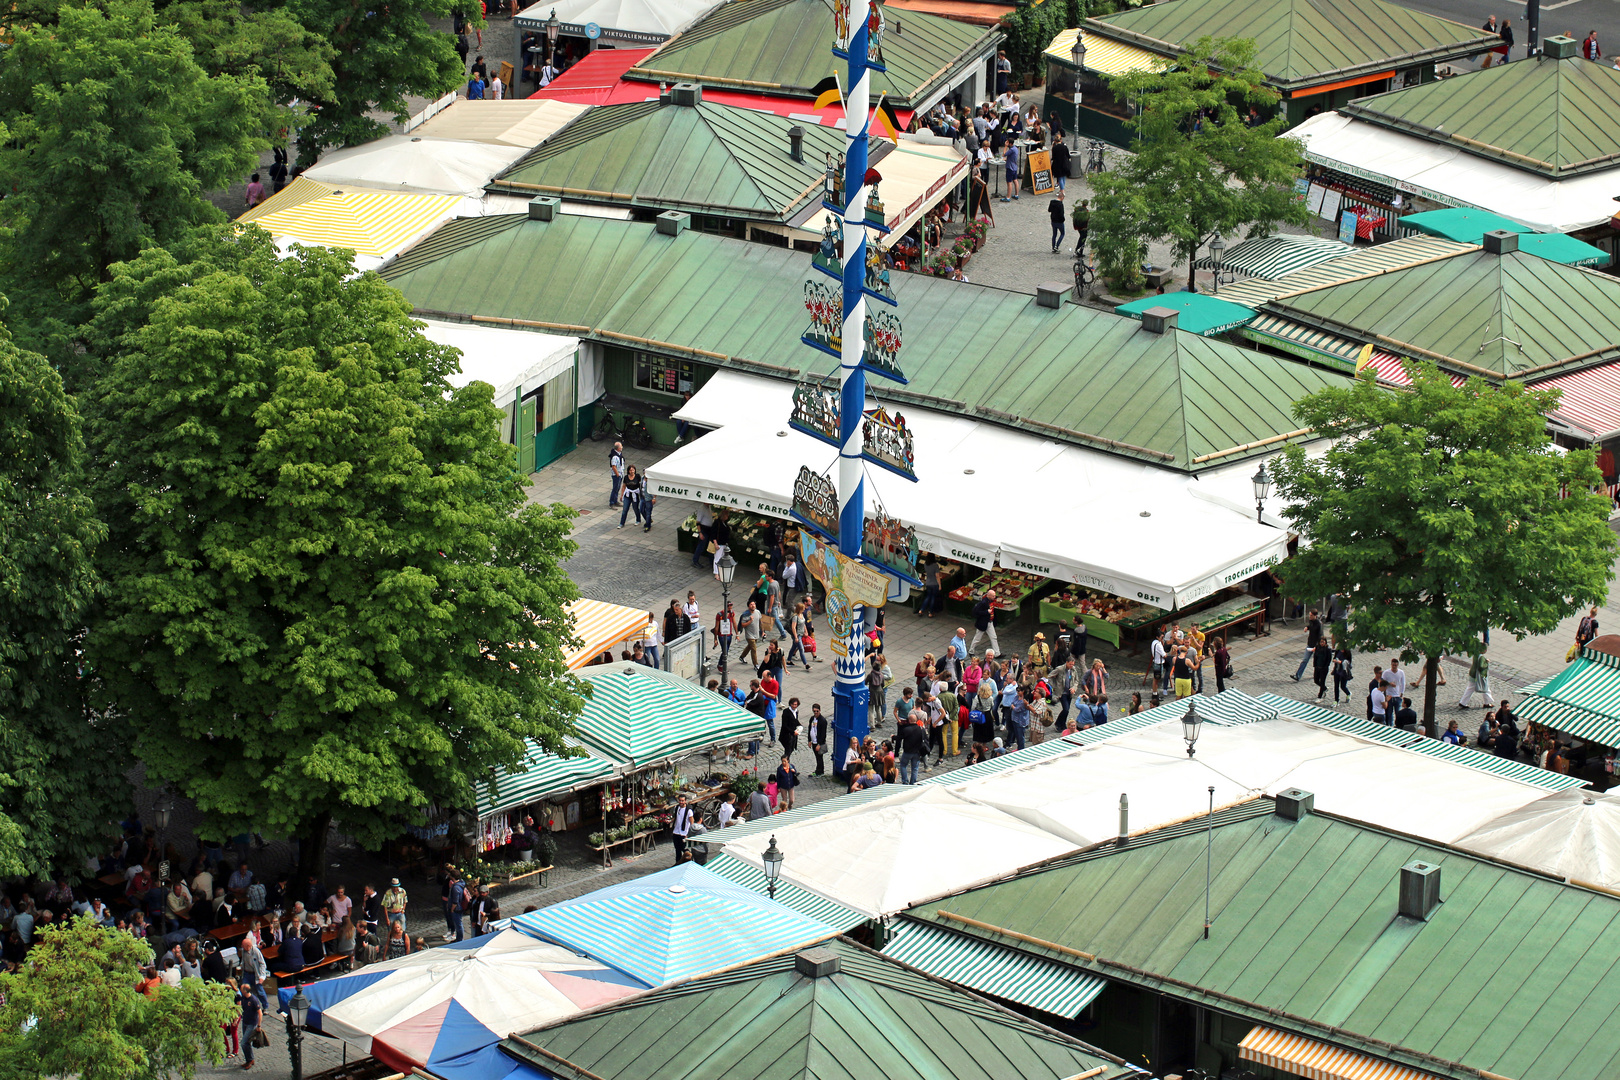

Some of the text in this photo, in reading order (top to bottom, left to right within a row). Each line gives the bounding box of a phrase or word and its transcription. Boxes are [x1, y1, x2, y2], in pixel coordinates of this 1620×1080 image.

[604, 30, 665, 43] VIKTUALIENMARKT
[1328, 159, 1339, 168] auf
[1339, 161, 1350, 171] dem
[1351, 167, 1393, 186] Viktualienmarkt
[1401, 182, 1417, 193] Bio-Tee
[1577, 257, 1598, 267] MARKT
[1204, 328, 1215, 337] BIO
[1216, 325, 1225, 333] AM
[1256, 334, 1270, 344] BIO
[1272, 339, 1285, 349] AM
[1287, 345, 1316, 359] MARKT
[1318, 355, 1336, 366] SEIT
[658, 485, 689, 496] KRAUT
[758, 503, 790, 515] KARTO
[951, 548, 986, 564] GEMÜSE
[1015, 560, 1050, 574] EXOTEN
[1137, 591, 1160, 603] OBST
